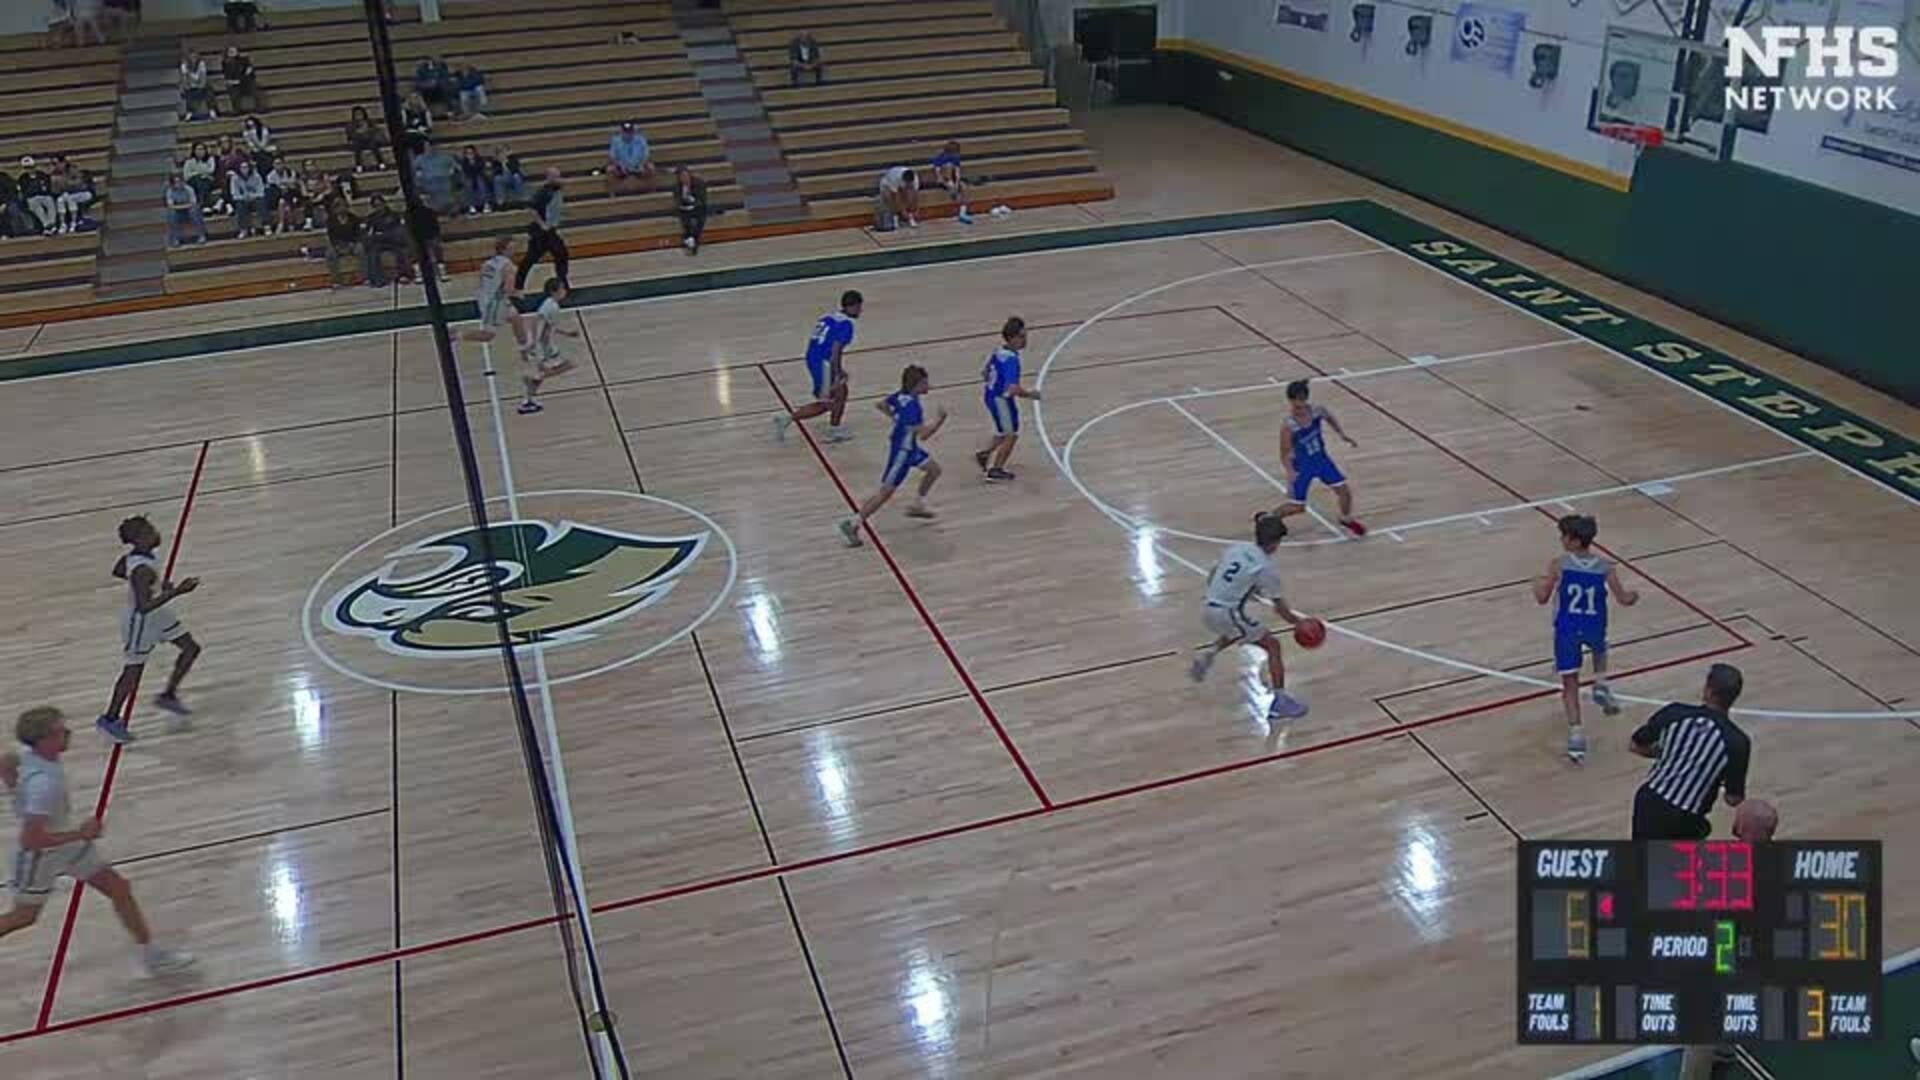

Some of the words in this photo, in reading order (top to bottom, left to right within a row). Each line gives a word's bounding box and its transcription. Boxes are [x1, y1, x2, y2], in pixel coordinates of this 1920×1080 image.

[1411, 239, 1627, 326] SAINT
[1223, 562, 1241, 583] 2
[1567, 583, 1598, 616] 21
